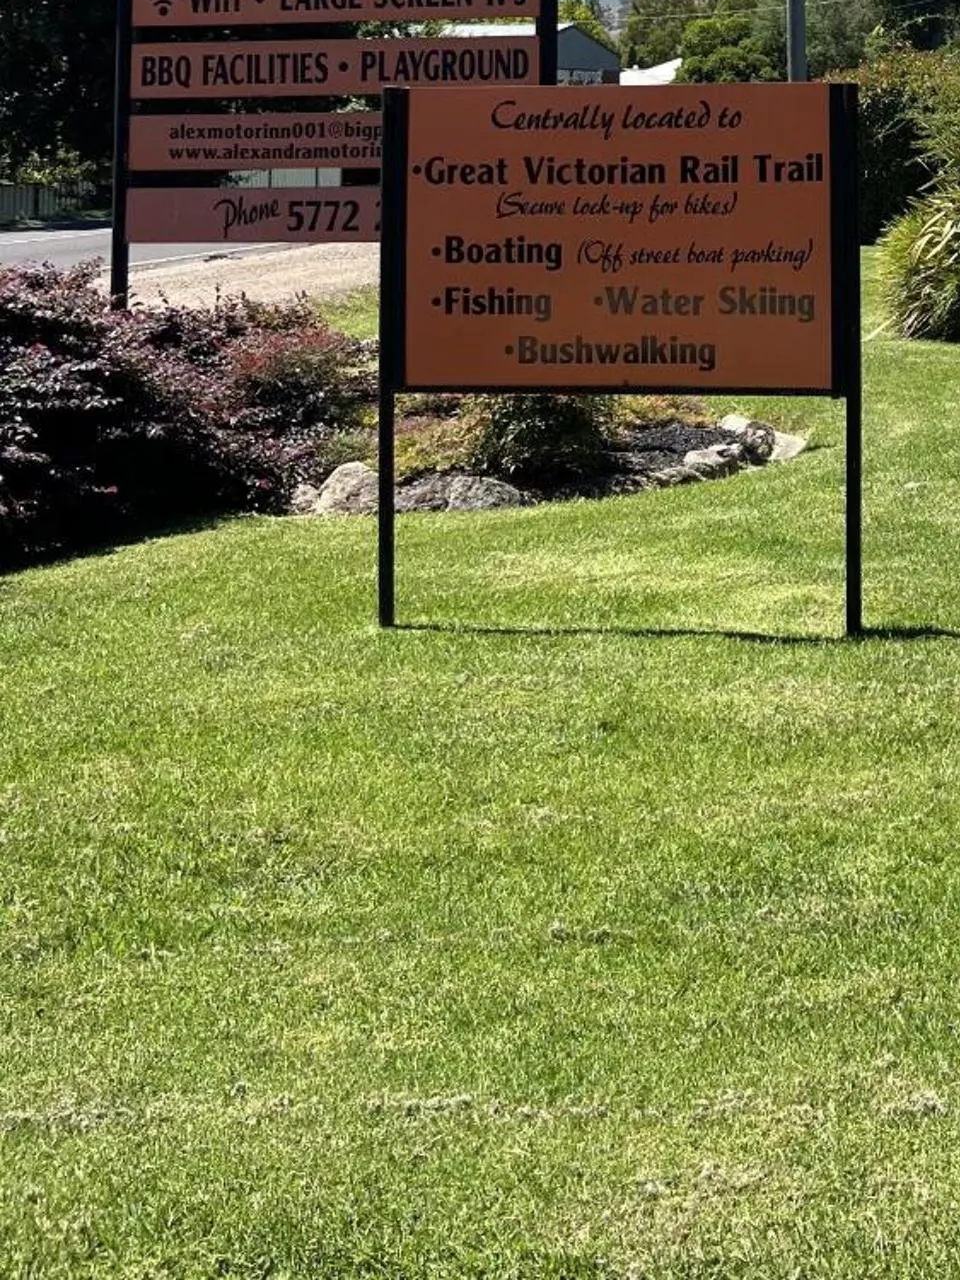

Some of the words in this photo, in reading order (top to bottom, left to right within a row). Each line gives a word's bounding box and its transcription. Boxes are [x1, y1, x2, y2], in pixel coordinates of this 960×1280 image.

[141, 56, 191, 88] BBQ
[202, 52, 329, 87] FACILITIES
[361, 48, 530, 82] PLAYGROUND
[491, 100, 613, 139] Centrally
[621, 100, 711, 129] located
[717, 105, 743, 129] to
[425, 157, 508, 185] Great
[523, 157, 666, 184] Victorian
[681, 155, 739, 184] Rail
[753, 153, 823, 182] Trail
[214, 196, 281, 239] Phone
[287, 200, 359, 232] 5772
[496, 193, 566, 219] (Secure
[573, 194, 643, 222] lock-up
[650, 194, 679, 222] for
[684, 192, 738, 215] bikes)
[444, 236, 563, 270] Boating
[577, 239, 622, 272] (Off
[630, 246, 680, 264] street
[687, 243, 724, 264] boat
[731, 239, 813, 272] parking)
[444, 287, 552, 321] Fishing
[605, 288, 705, 315] Water
[718, 287, 815, 322] Skiing
[517, 335, 716, 371] Bushwalking
